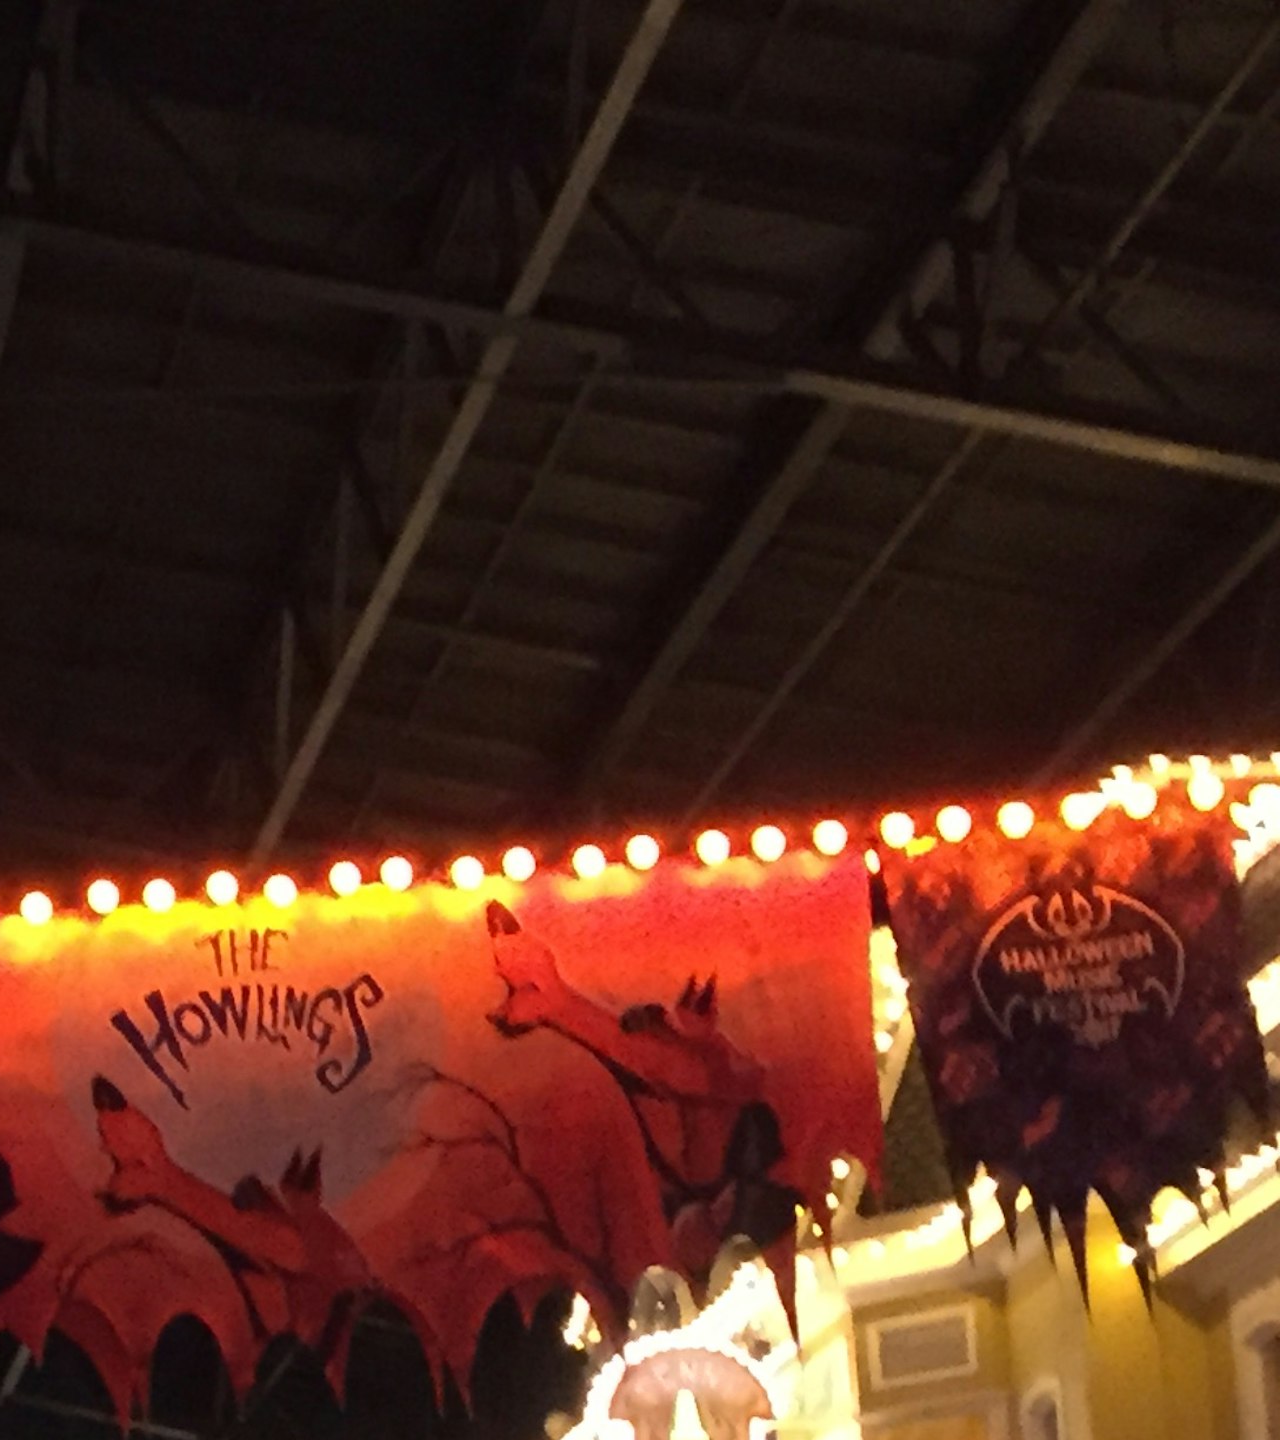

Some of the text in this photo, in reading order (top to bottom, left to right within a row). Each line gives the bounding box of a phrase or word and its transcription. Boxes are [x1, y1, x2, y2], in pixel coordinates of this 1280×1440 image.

[194, 926, 289, 977] THE
[1000, 931, 1153, 974] HALLOWEEN
[110, 972, 385, 1111] HOWLINGS
